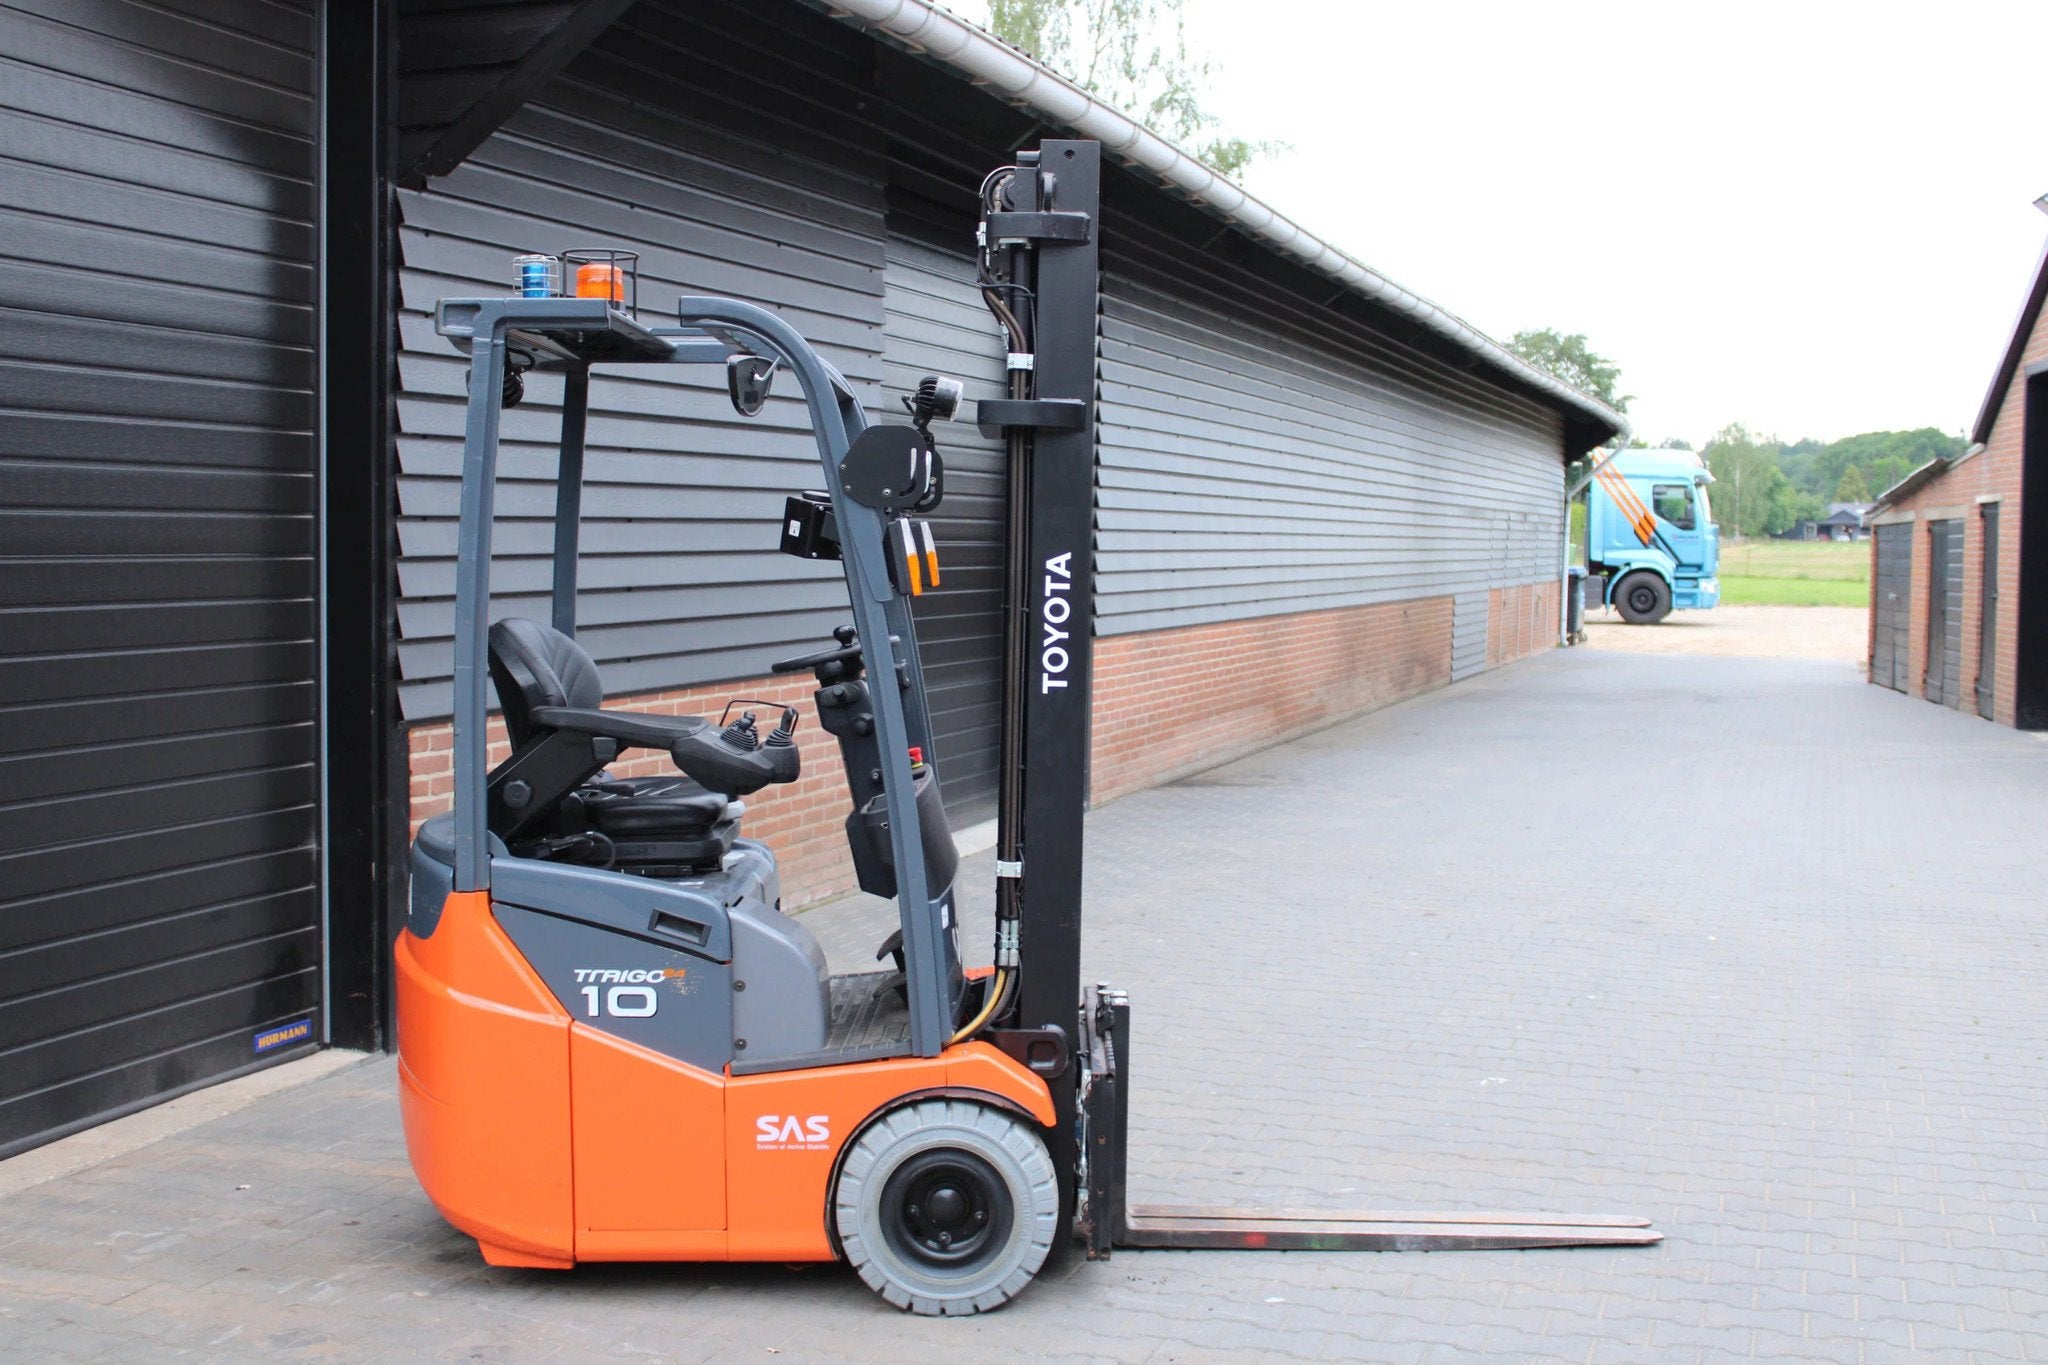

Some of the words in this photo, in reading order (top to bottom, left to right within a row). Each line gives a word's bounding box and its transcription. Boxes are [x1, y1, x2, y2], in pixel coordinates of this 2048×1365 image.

[1042, 552, 1072, 695] TOYOTA
[581, 985, 658, 1018] 10
[756, 1115, 830, 1142] SAS
